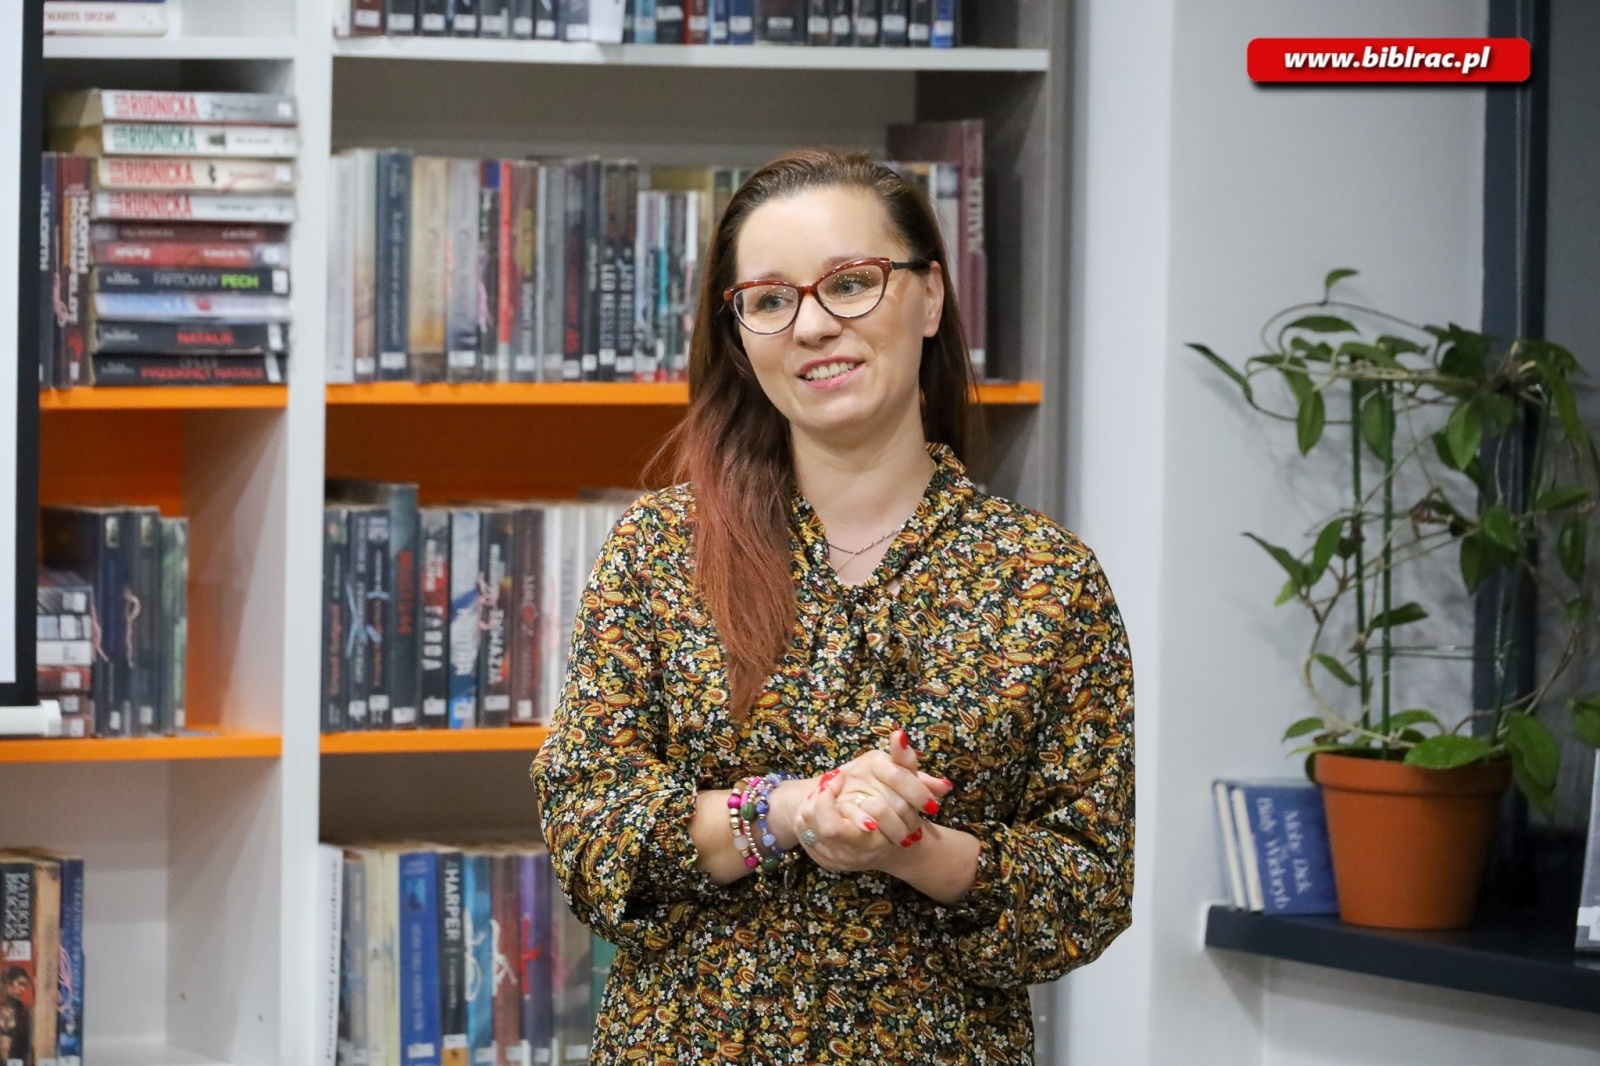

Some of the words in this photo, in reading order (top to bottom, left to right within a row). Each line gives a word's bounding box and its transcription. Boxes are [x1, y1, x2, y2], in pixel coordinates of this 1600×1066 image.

[130, 95, 199, 117] RUDNICKA
[129, 126, 197, 150] RUDNICKA
[125, 161, 195, 185] RUDNICKA
[124, 193, 193, 217] RUDNICKA
[220, 274, 260, 288] PECH
[1292, 858, 1313, 894] Dick
[16, 872, 30, 938] PATRICIA
[444, 868, 460, 940] HARPER
